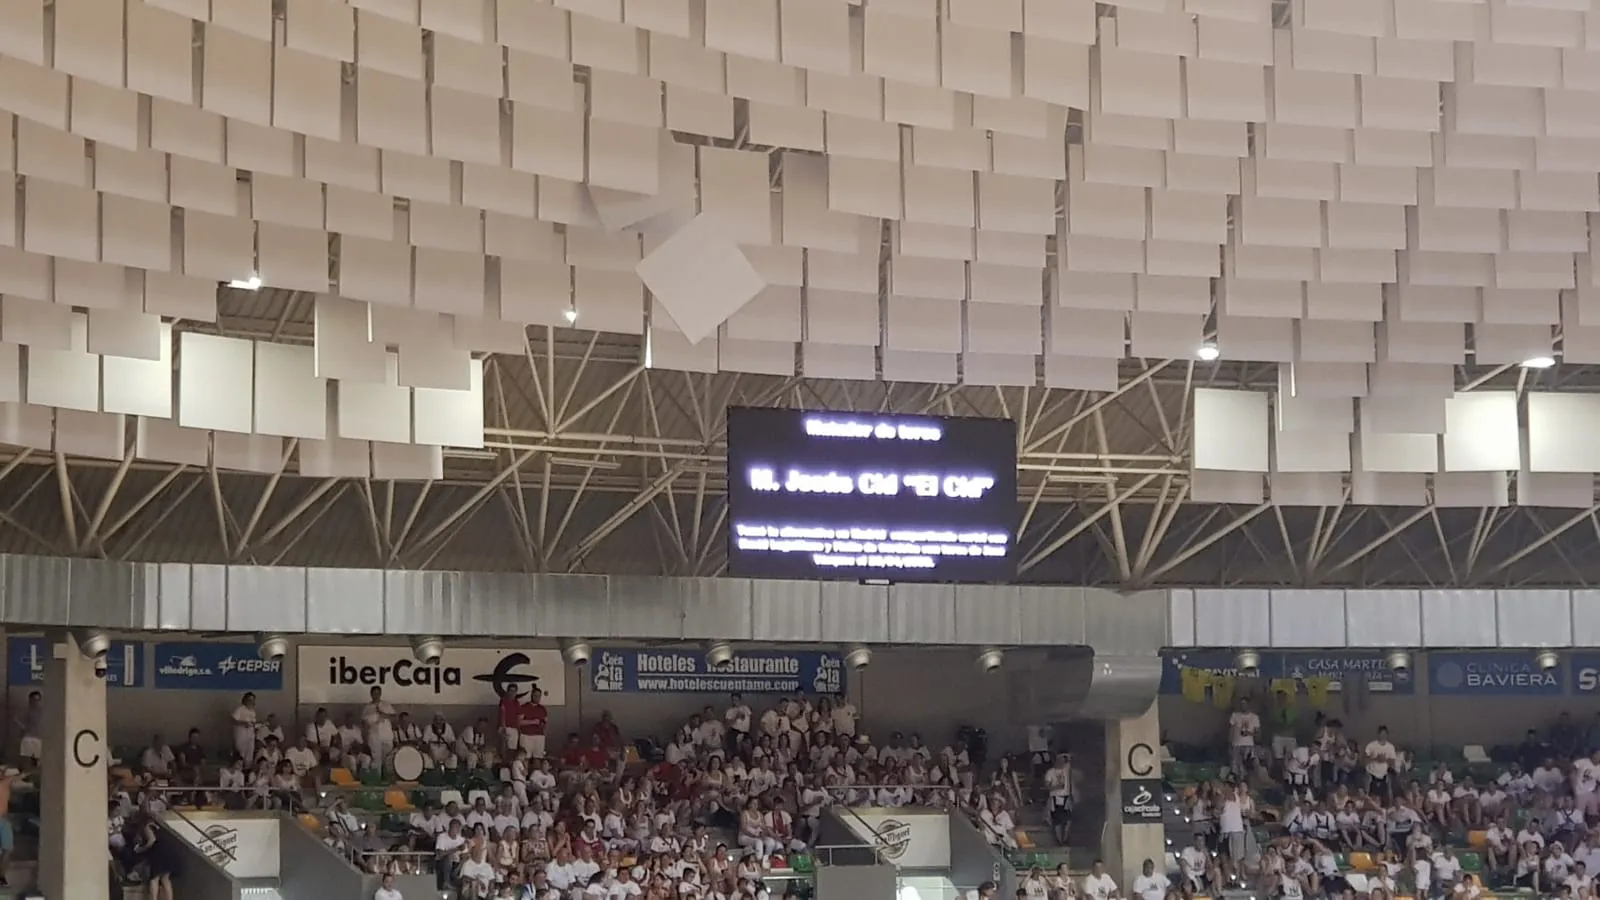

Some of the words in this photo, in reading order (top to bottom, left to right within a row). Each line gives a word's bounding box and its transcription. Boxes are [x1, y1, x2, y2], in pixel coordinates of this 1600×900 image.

[237, 659, 281, 673] CEPSA
[637, 653, 696, 672] Hoteles
[1308, 658, 1340, 670] CASA
[329, 656, 461, 693] iberCaja
[1467, 673, 1557, 687] BAVIERA
[638, 677, 799, 691] www.hotelescuentame.com
[73, 729, 99, 767] C
[1127, 743, 1154, 776] C
